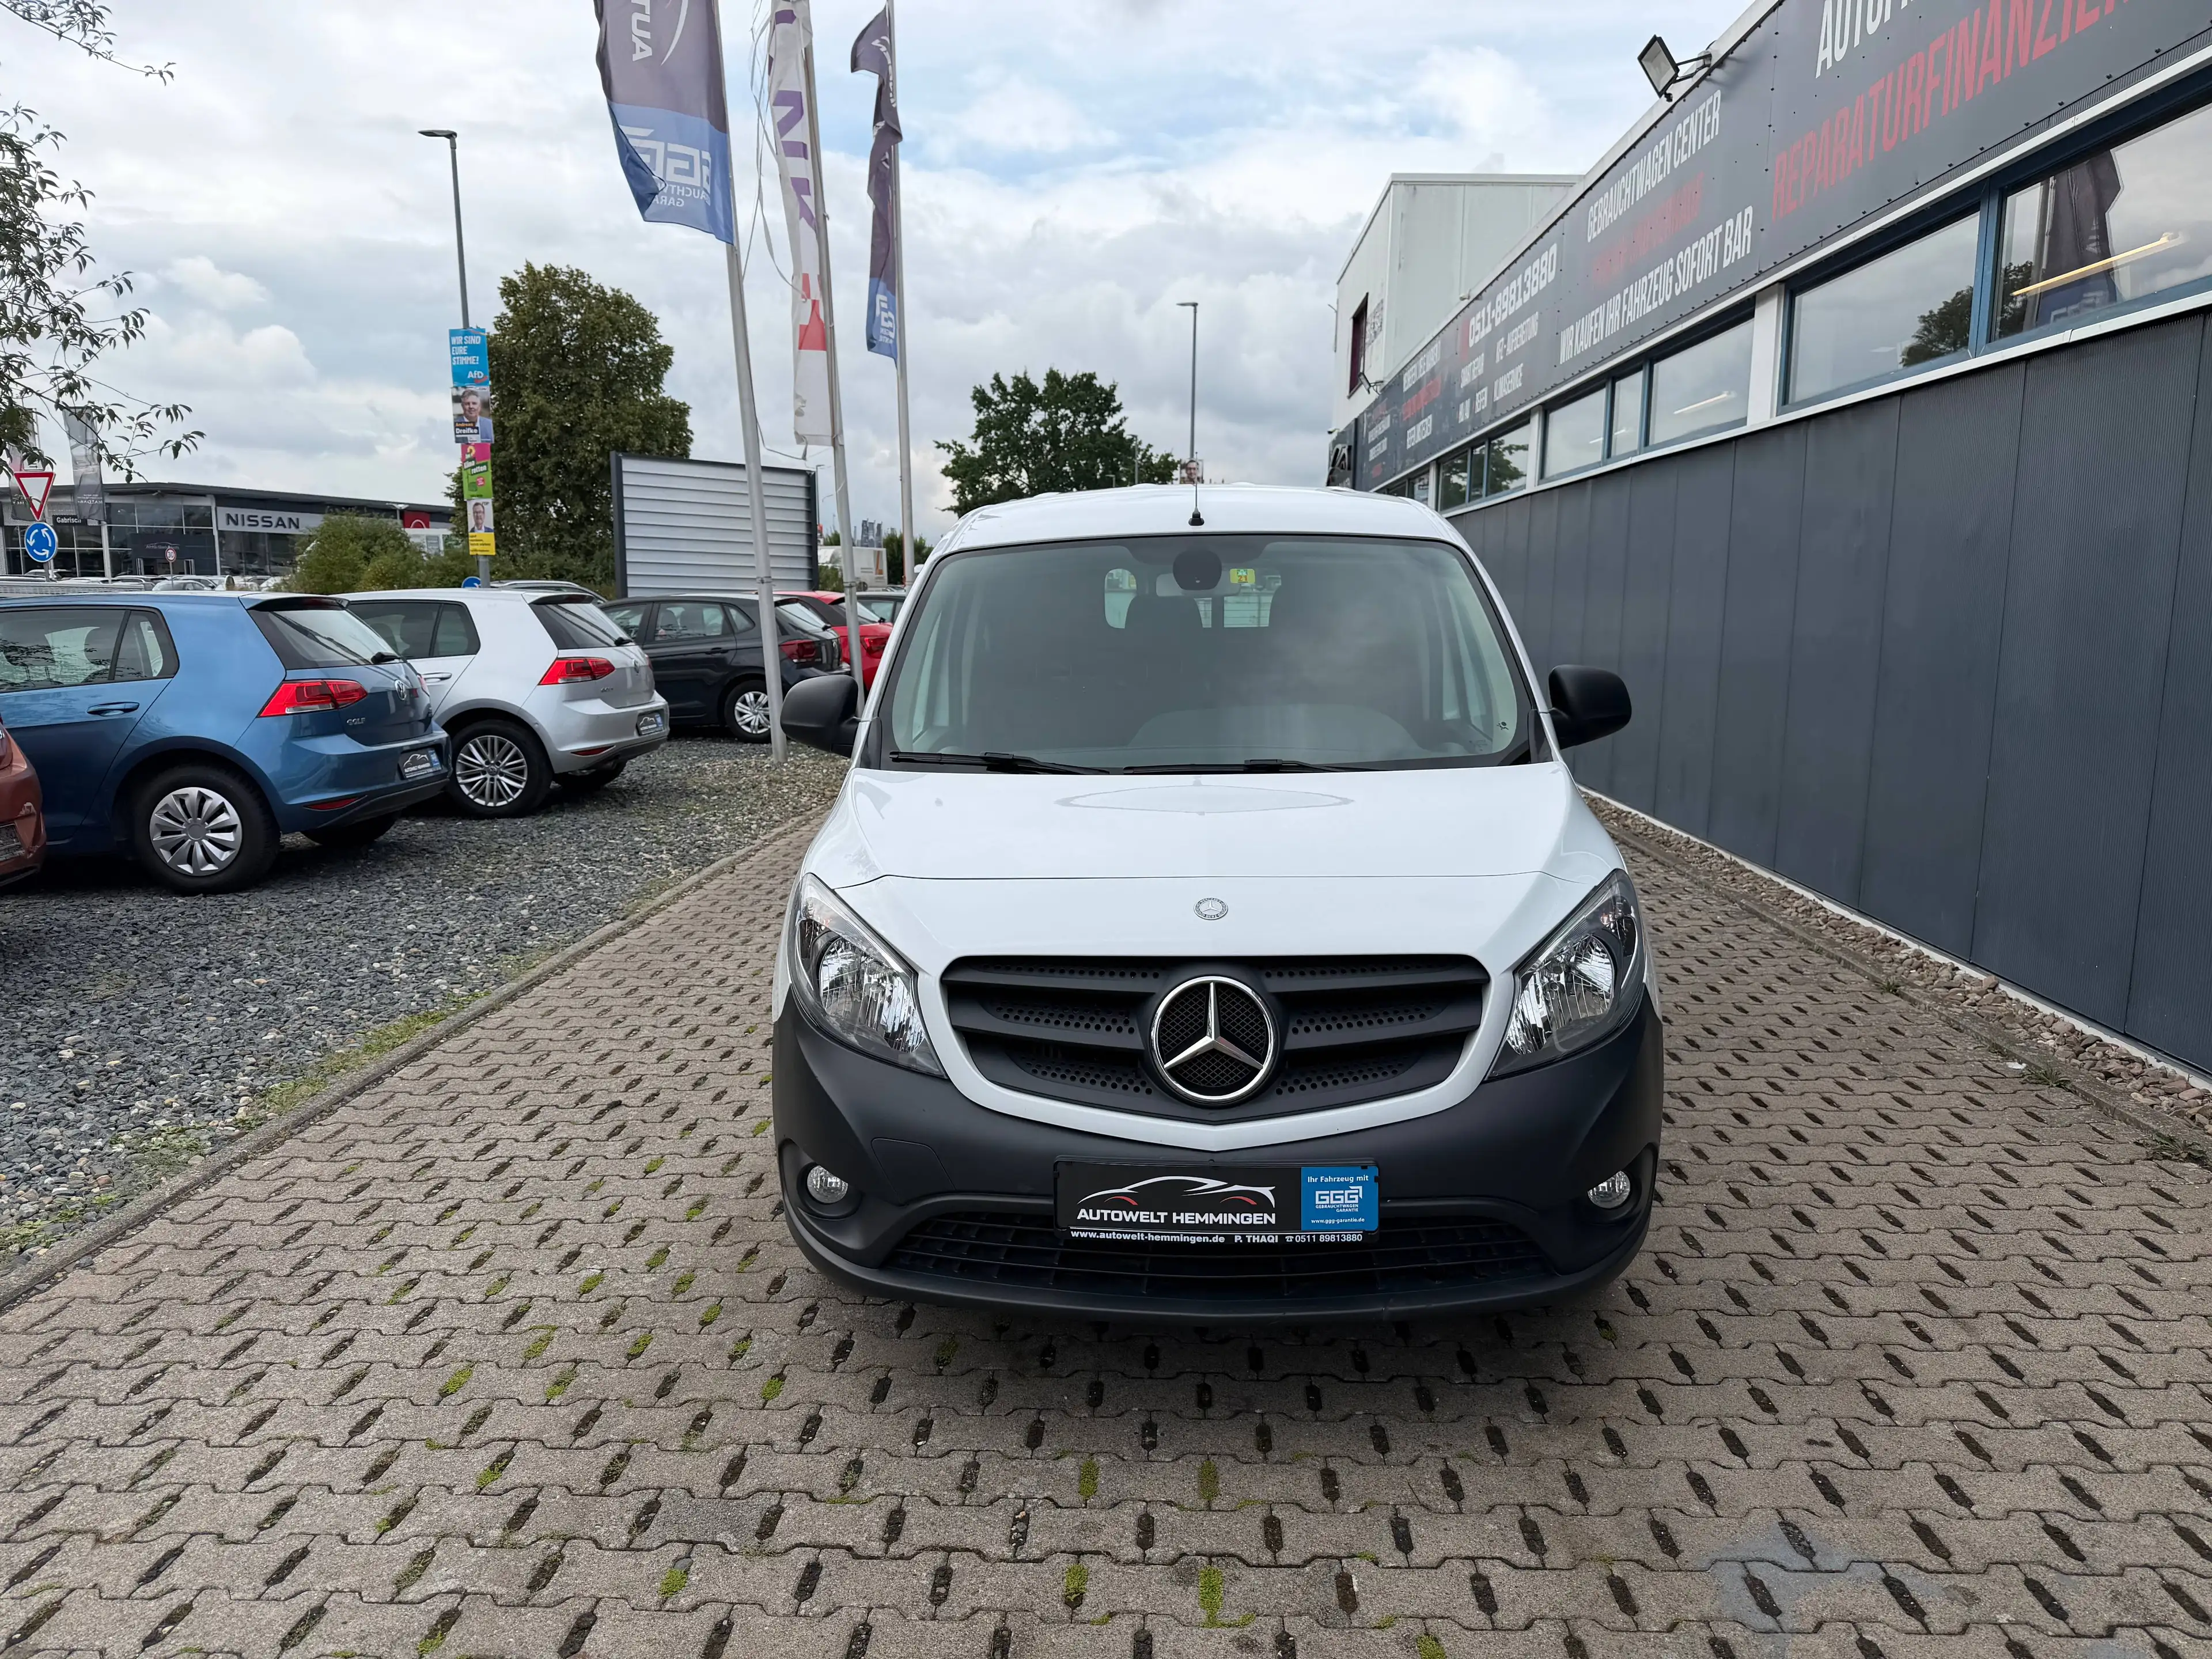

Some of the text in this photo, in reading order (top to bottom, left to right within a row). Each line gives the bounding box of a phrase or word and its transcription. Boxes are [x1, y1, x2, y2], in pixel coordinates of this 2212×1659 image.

[1588, 131, 1673, 243] GEBRAUCHTWAGEN
[1673, 90, 1721, 168] CENTER
[1559, 327, 1574, 365] WIR
[1574, 303, 1605, 356] KAUFEN
[1605, 293, 1622, 338] IHR
[1621, 257, 1673, 328] FAHRZEUG
[1675, 224, 1723, 296] SOFORT
[1723, 206, 1753, 268] BAR
[1469, 243, 1557, 348] 0511-89813880
[451, 336, 481, 344] WIR SIND
[452, 346, 468, 355] EURE
[452, 356, 479, 365] STIMME!
[467, 370, 484, 378] AfD
[225, 513, 300, 529] NISSAN
[347, 717, 366, 725] GOLF
[1316, 1190, 1358, 1205] GGG
[1077, 1209, 1276, 1225] AUTOWELT HEMMINGEN
[1070, 1230, 1363, 1244] www.autowelt-hemmingen.de P. THAQI 0511 89813880
